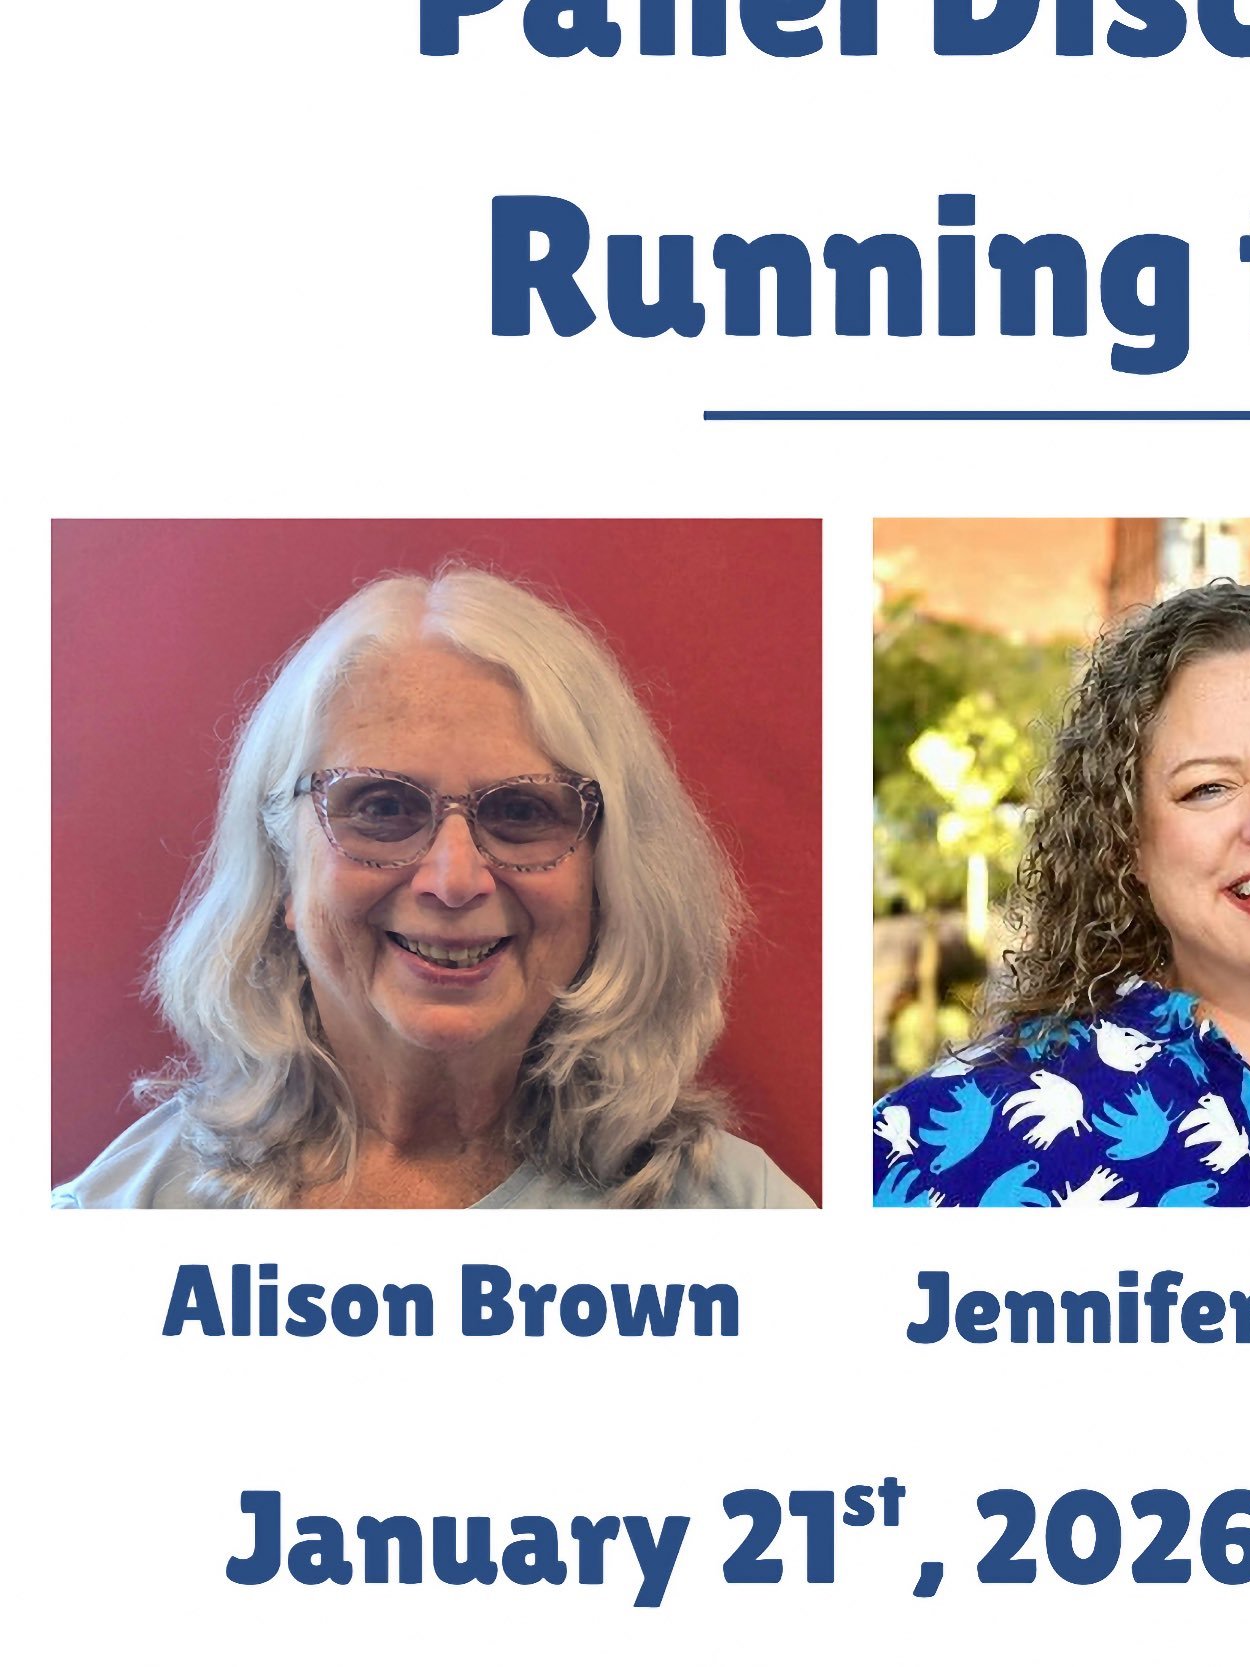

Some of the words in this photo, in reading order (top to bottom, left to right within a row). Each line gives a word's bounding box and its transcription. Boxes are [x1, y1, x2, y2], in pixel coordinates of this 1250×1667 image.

[492, 194, 1189, 375] Running
[162, 1264, 433, 1337] Alison
[462, 1264, 738, 1337] Brown
[226, 1491, 690, 1607] January
